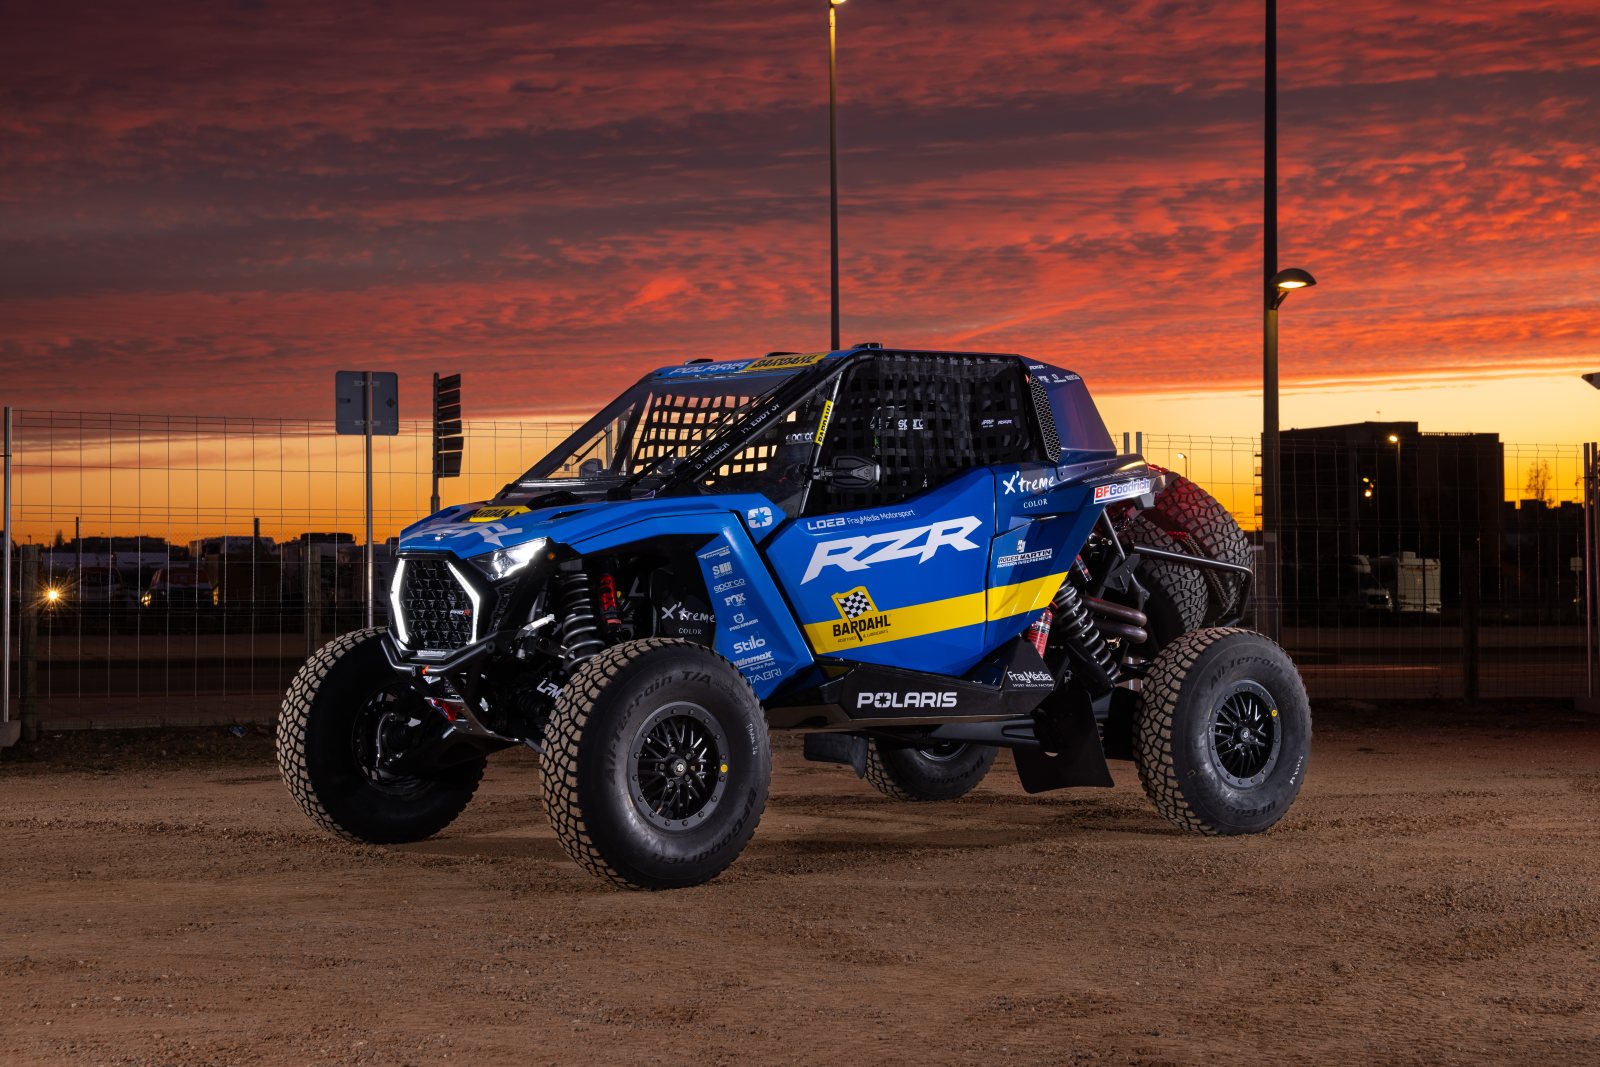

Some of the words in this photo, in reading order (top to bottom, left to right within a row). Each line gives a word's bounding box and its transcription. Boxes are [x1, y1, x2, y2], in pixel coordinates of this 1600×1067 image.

[669, 361, 749, 375] POLARIS
[751, 354, 818, 369] BARDAHL
[751, 409, 771, 428] EDDY
[1095, 477, 1150, 499] BFGoodrich
[1023, 498, 1048, 509] COLOR
[807, 517, 846, 531] LOEB
[880, 509, 916, 521] Motorsport
[800, 515, 983, 586] RZR
[998, 555, 1019, 564] ROGER
[1019, 548, 1052, 560] MARTIN
[713, 578, 746, 594] sparco
[724, 592, 746, 607] FOX
[678, 627, 702, 635] COLOR
[833, 614, 892, 638] BARDAHL
[733, 635, 766, 655] Stilo
[732, 650, 772, 668] Winmax
[682, 670, 712, 688] T/A
[856, 691, 957, 708] POLARIS
